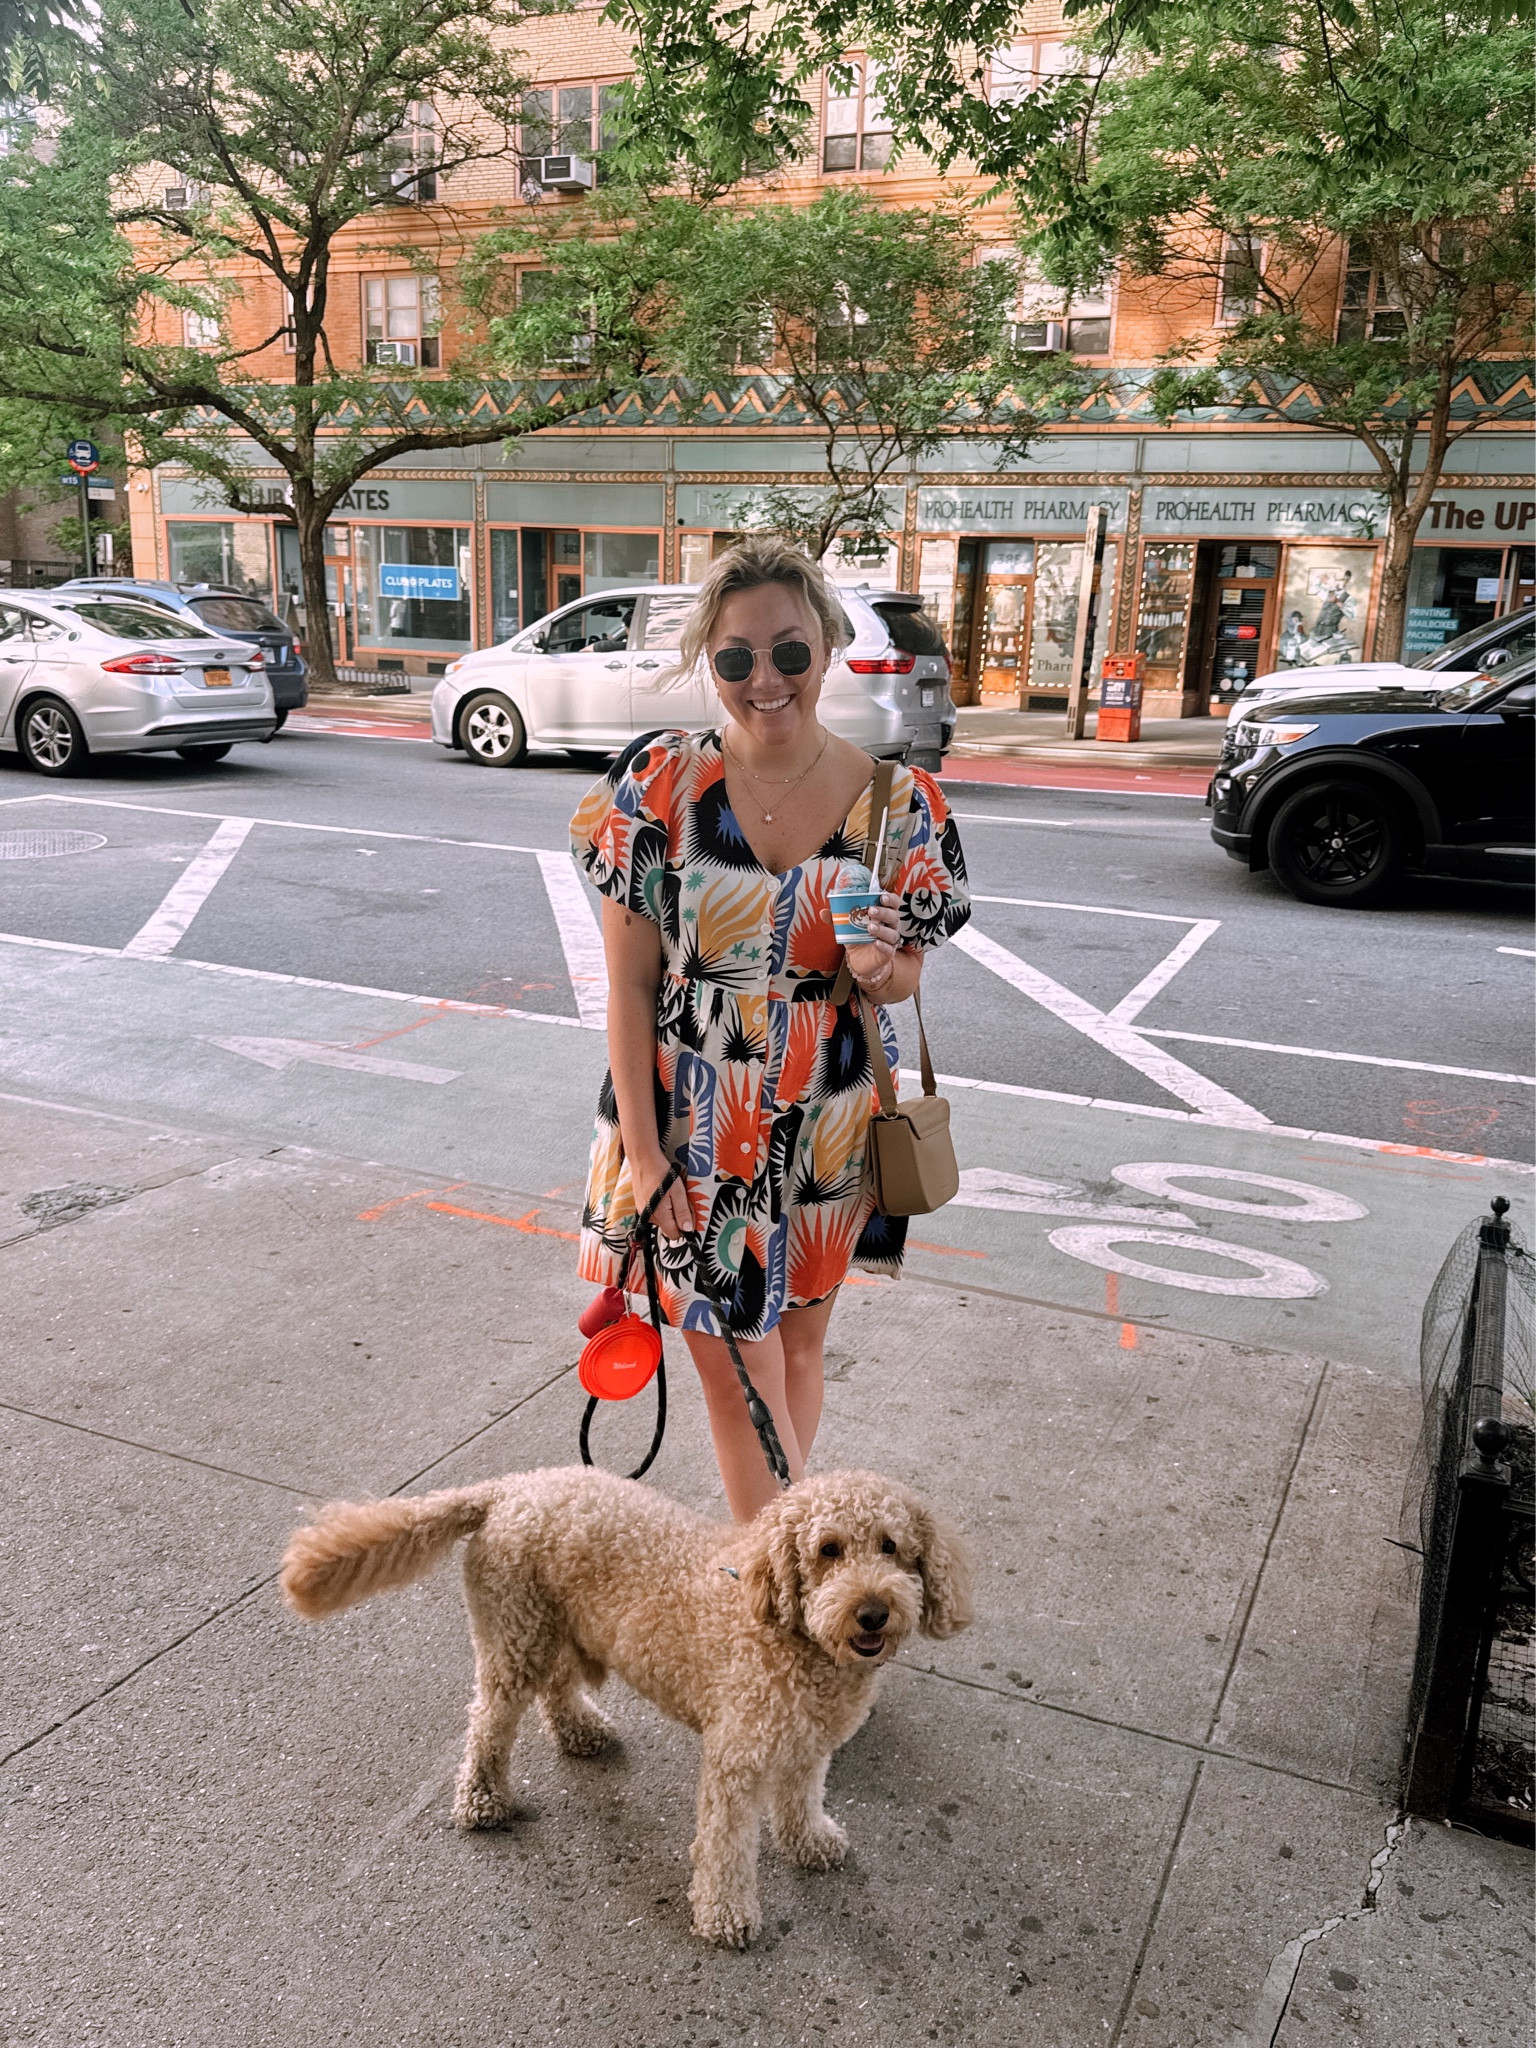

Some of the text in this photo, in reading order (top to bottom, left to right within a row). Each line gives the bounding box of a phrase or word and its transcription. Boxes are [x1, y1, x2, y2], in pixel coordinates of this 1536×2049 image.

[924, 501, 1121, 520] PROHEALTH PHARMY
[1155, 501, 1377, 523] PROHEALTH PHARMACY
[1429, 501, 1485, 530] The
[418, 577, 453, 589] PILATES
[1409, 608, 1450, 618] PRINTING
[1407, 619, 1458, 630] MAILBOXES
[1406, 631, 1444, 641] PACKING
